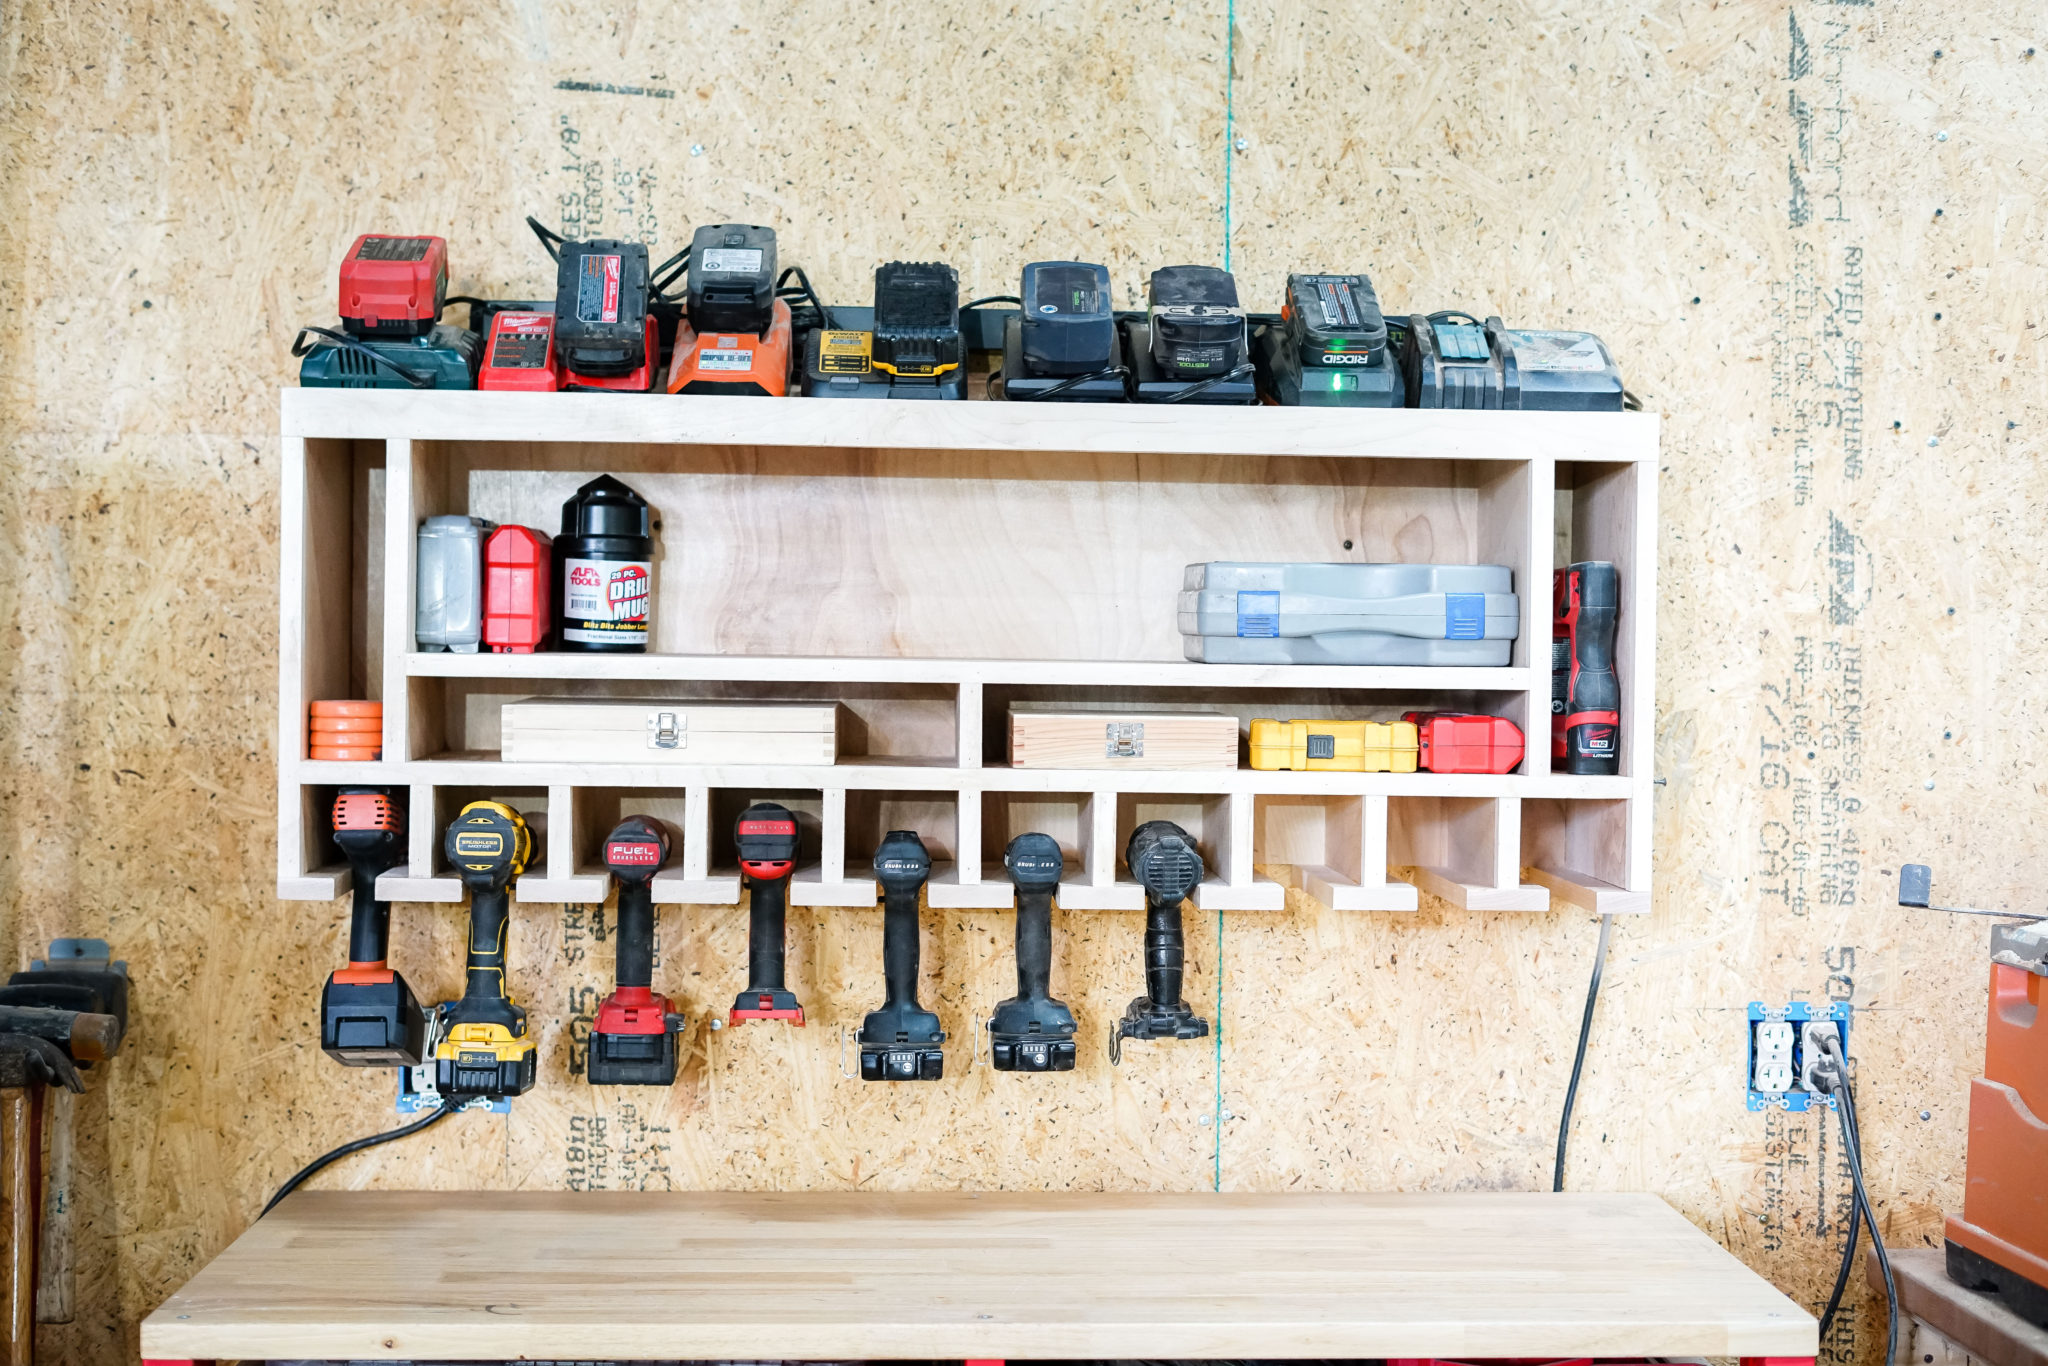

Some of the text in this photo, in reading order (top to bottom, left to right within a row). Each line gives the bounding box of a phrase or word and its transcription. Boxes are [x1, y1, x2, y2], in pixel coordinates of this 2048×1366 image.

[1322, 354, 1369, 364] RIDGID
[1844, 246, 1863, 481] RATED SHEATHING
[1178, 361, 1210, 369] FESTOOL
[611, 571, 621, 580] 29
[570, 577, 601, 587] TOOLS
[1843, 645, 1862, 782] THICKNESS
[613, 846, 653, 855] FUEL
[1760, 821, 1790, 907] CAT
[1837, 1303, 1856, 1364] THIS
